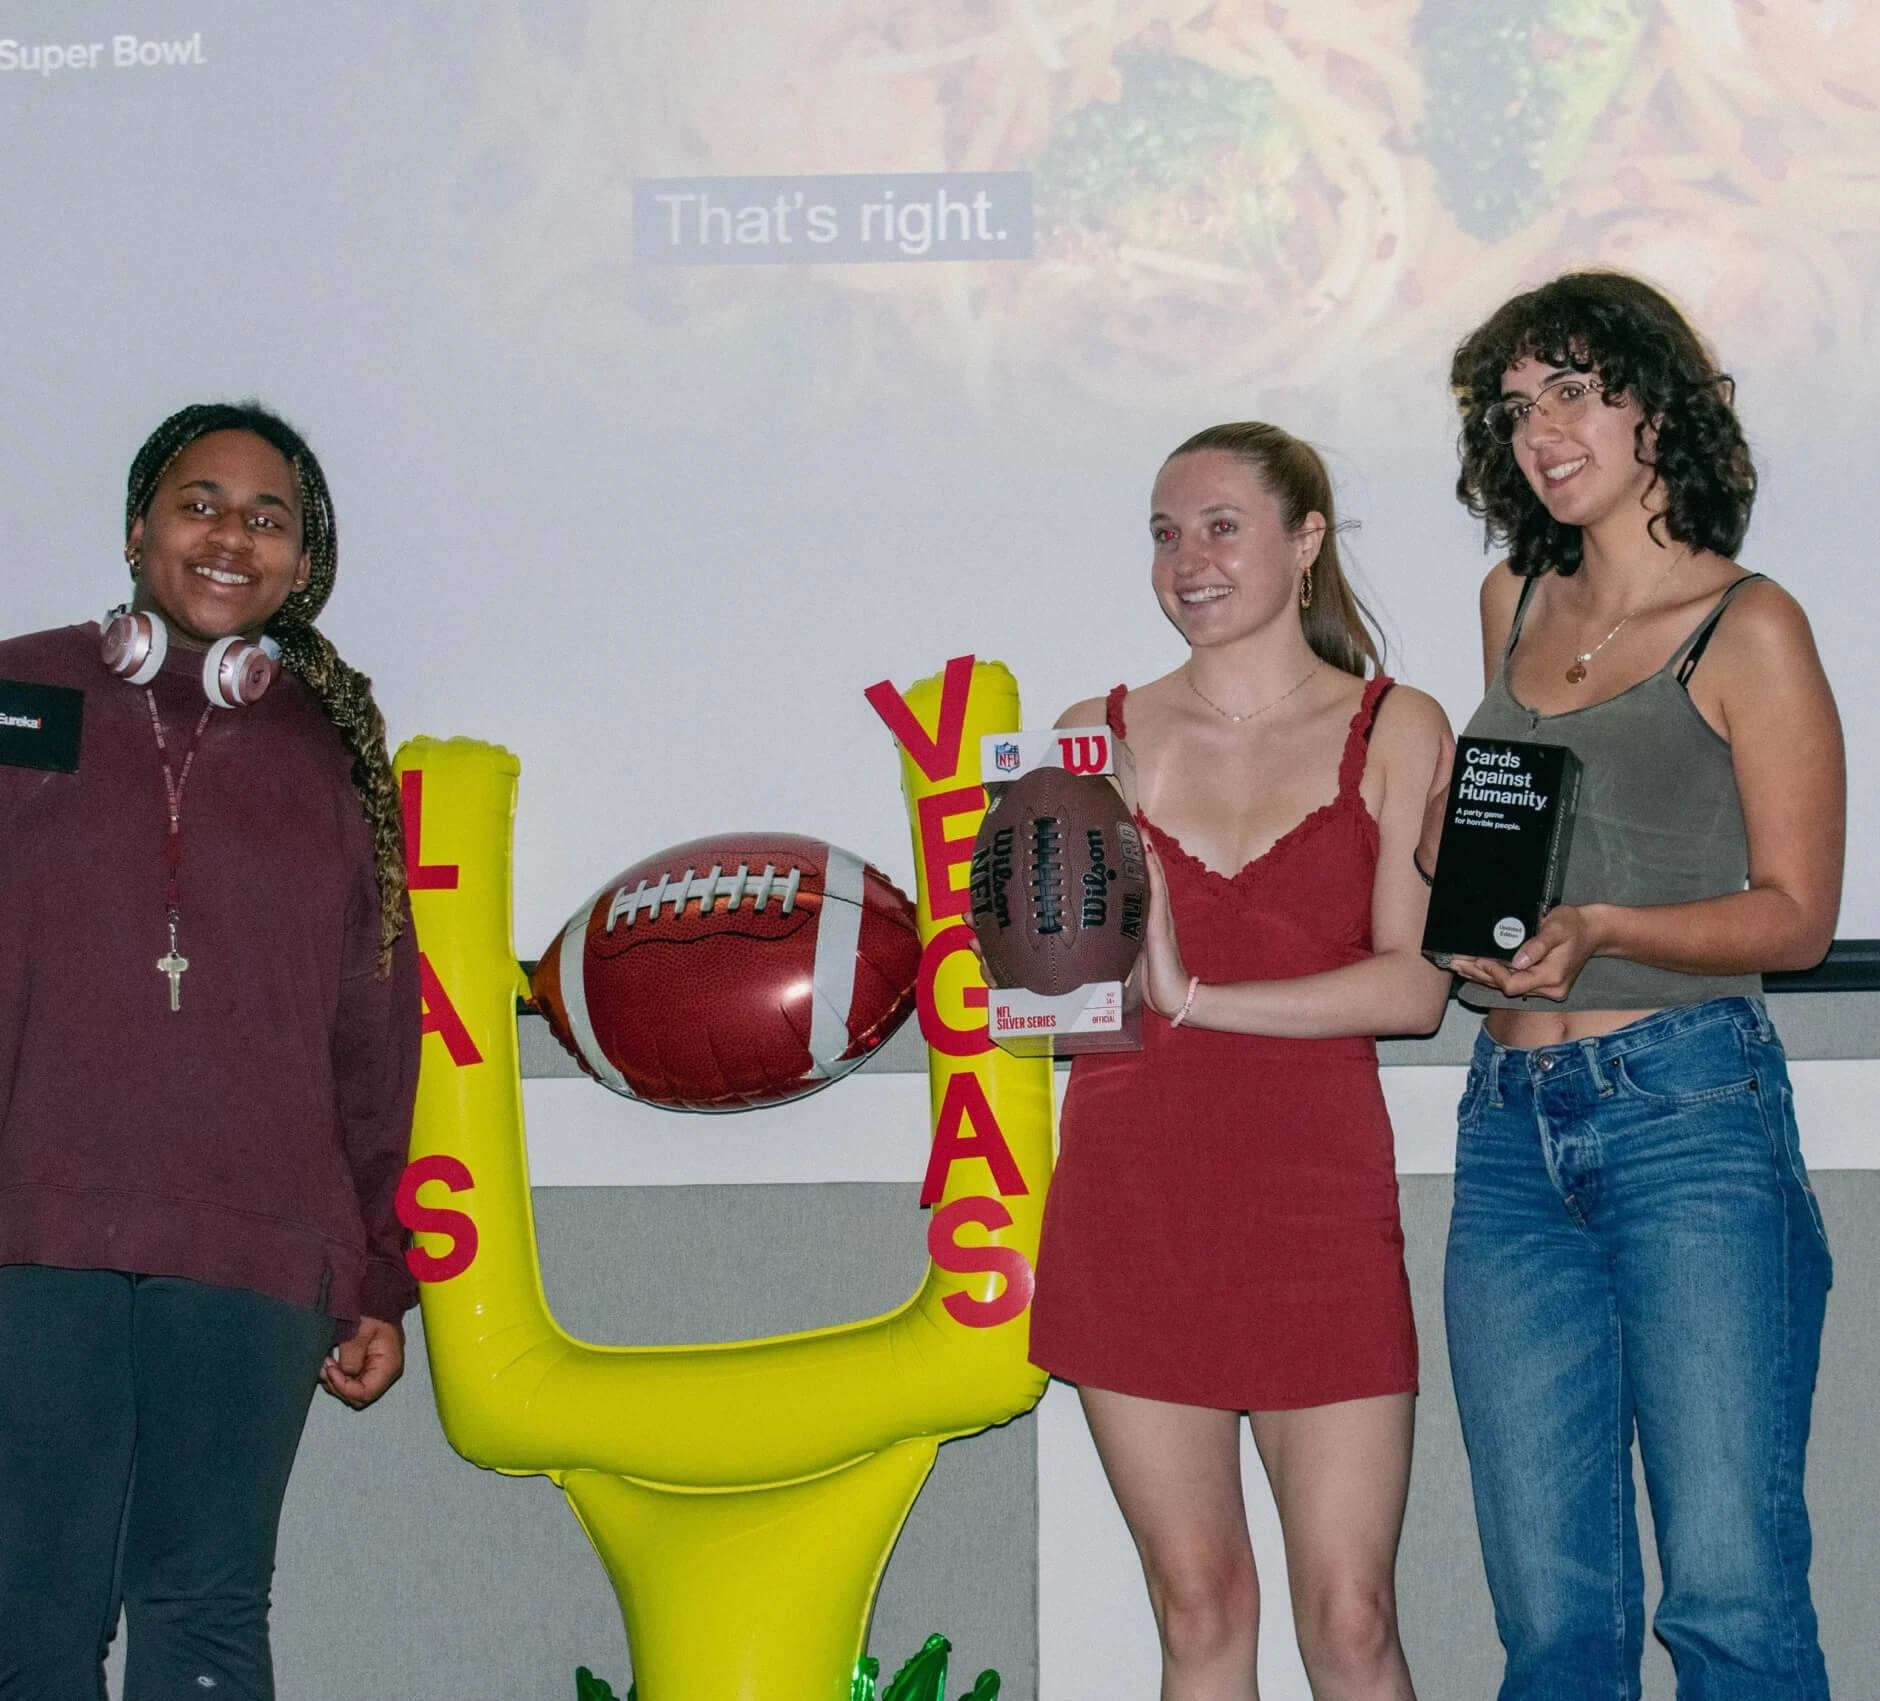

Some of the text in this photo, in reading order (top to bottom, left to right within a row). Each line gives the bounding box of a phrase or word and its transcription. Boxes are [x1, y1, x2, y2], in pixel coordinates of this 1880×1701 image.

[0, 32, 208, 77] Super Bowl
[656, 190, 1008, 254] That's right.
[999, 753, 1020, 766] NFL
[1465, 747, 1521, 768] Cards
[1461, 765, 1532, 788] Against
[1456, 807, 1462, 815] A
[1463, 809, 1483, 818] party
[1466, 818, 1494, 828] horrible
[993, 826, 1014, 929] Wilson
[1081, 827, 1115, 929] Wilson
[996, 1006, 1011, 1018] NFL
[1092, 1015, 1115, 1024] OFFICIAL
[997, 1015, 1056, 1030] SILVER SERIES
